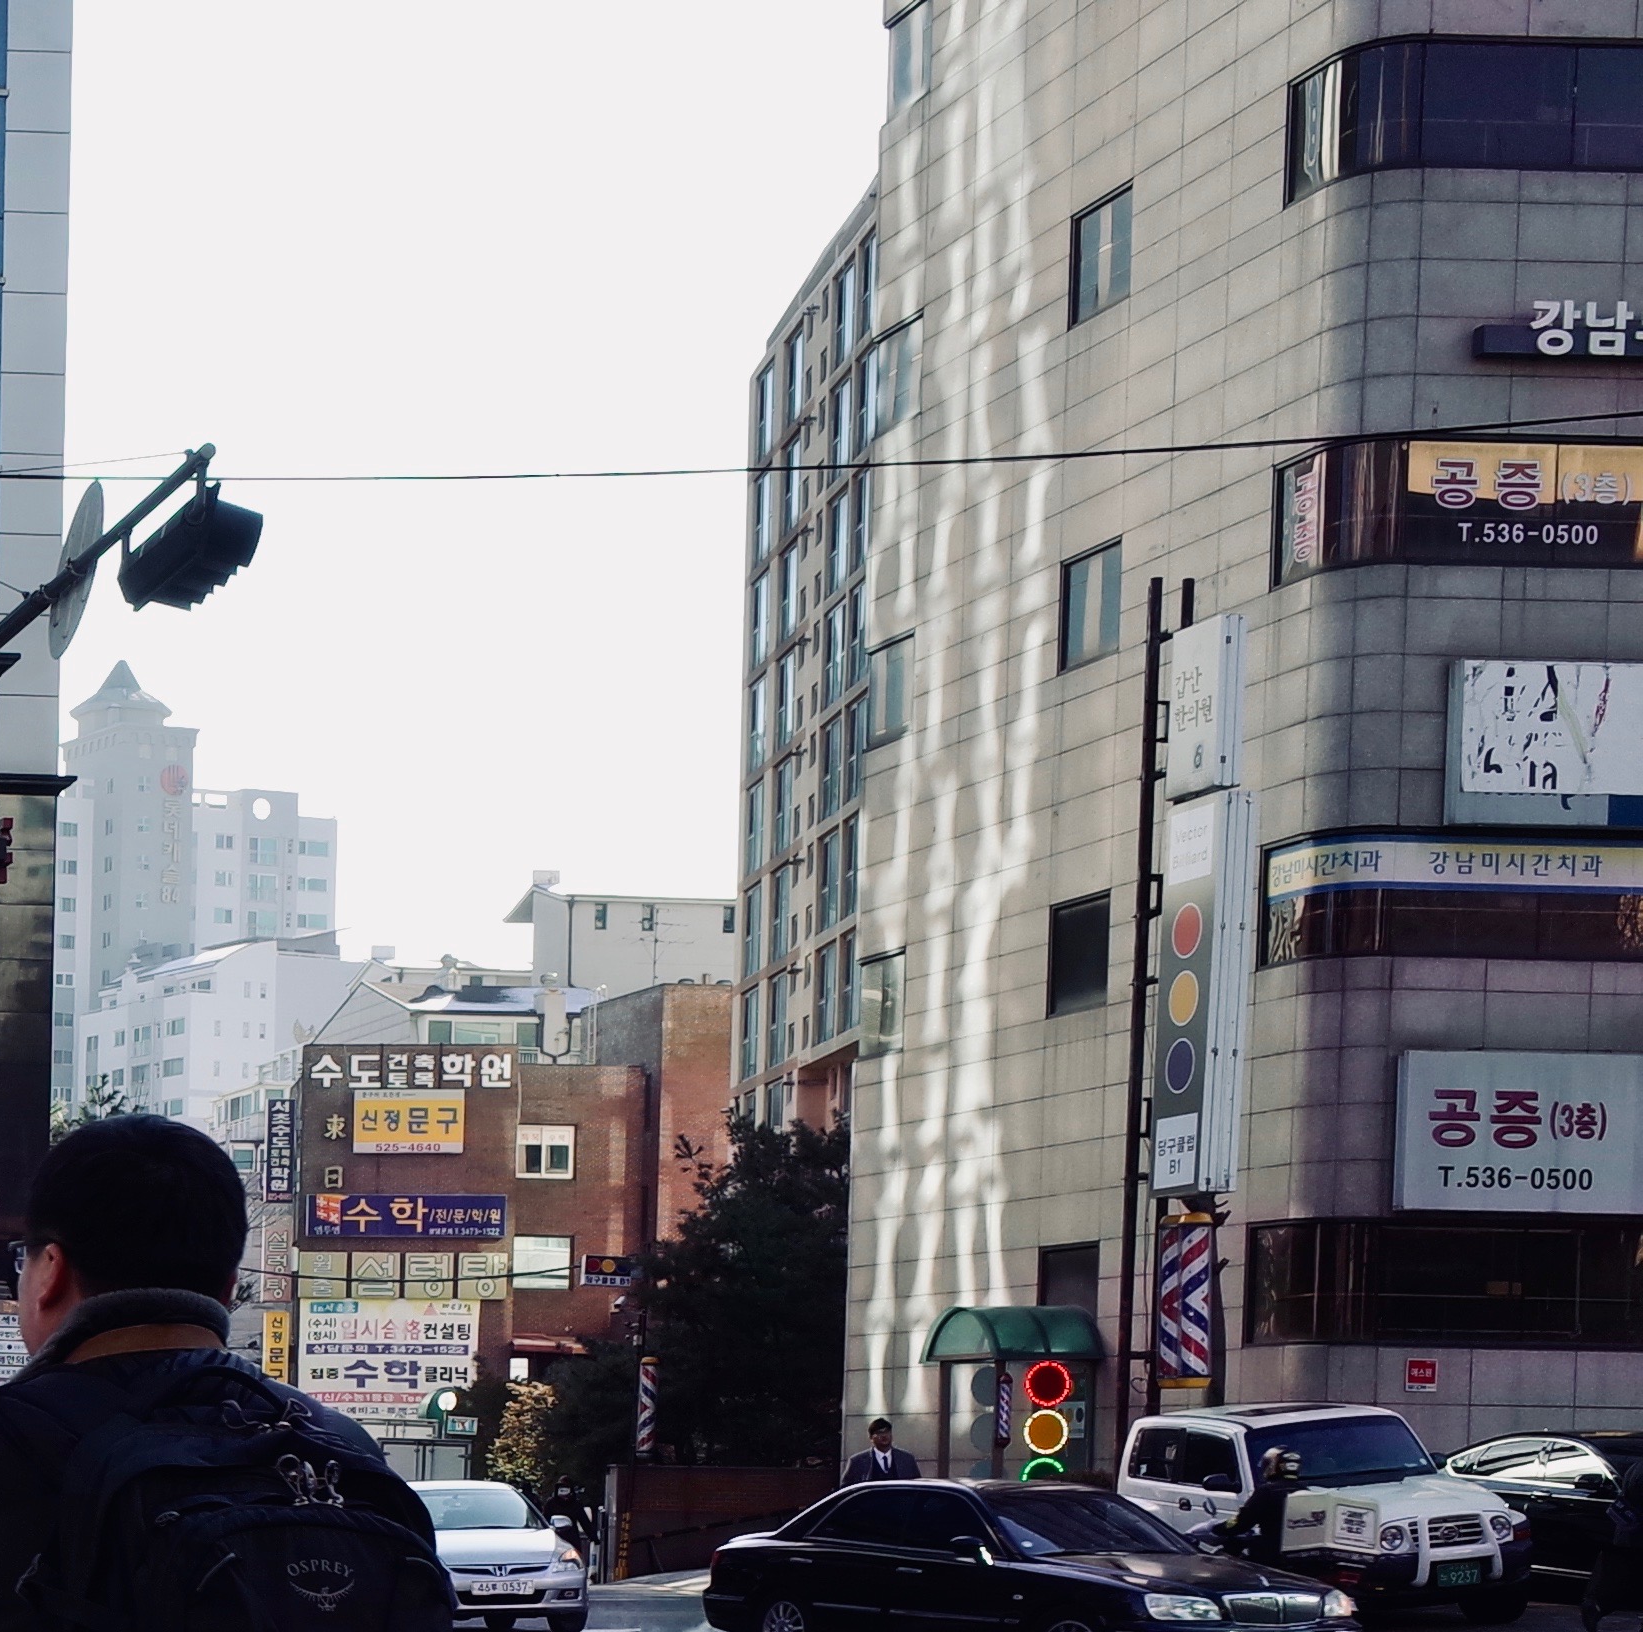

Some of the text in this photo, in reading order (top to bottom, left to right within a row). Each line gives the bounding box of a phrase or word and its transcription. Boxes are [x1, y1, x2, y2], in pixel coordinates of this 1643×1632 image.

[1530, 299, 1643, 357] 강남
[1432, 458, 1631, 511] 공증 (3층)
[1458, 522, 1599, 546] T.536-0500
[1174, 694, 1213, 732] 한의원
[1271, 849, 1383, 888] 강남미시간치과
[1428, 850, 1603, 878] 강남미시간치과
[310, 1053, 383, 1089] 수도
[440, 1053, 512, 1089] 학원
[361, 1107, 459, 1135] 신정문구
[1428, 1088, 1607, 1149] 공증 (3층)
[375, 1143, 442, 1152] 525-4640
[1437, 1165, 1593, 1191] T.536-0500
[342, 1196, 429, 1233] 수학
[267, 1230, 289, 1299] 설렁탕
[356, 1253, 506, 1299] 설렁탕
[423, 1322, 472, 1341] 컨설팅
[376, 1345, 466, 1355] T.3473-1522
[343, 1359, 422, 1389] 수학
[424, 1366, 468, 1384] 클리닉
[286, 1558, 355, 1579] OSPREY
[1449, 1568, 1478, 1585] 9237
